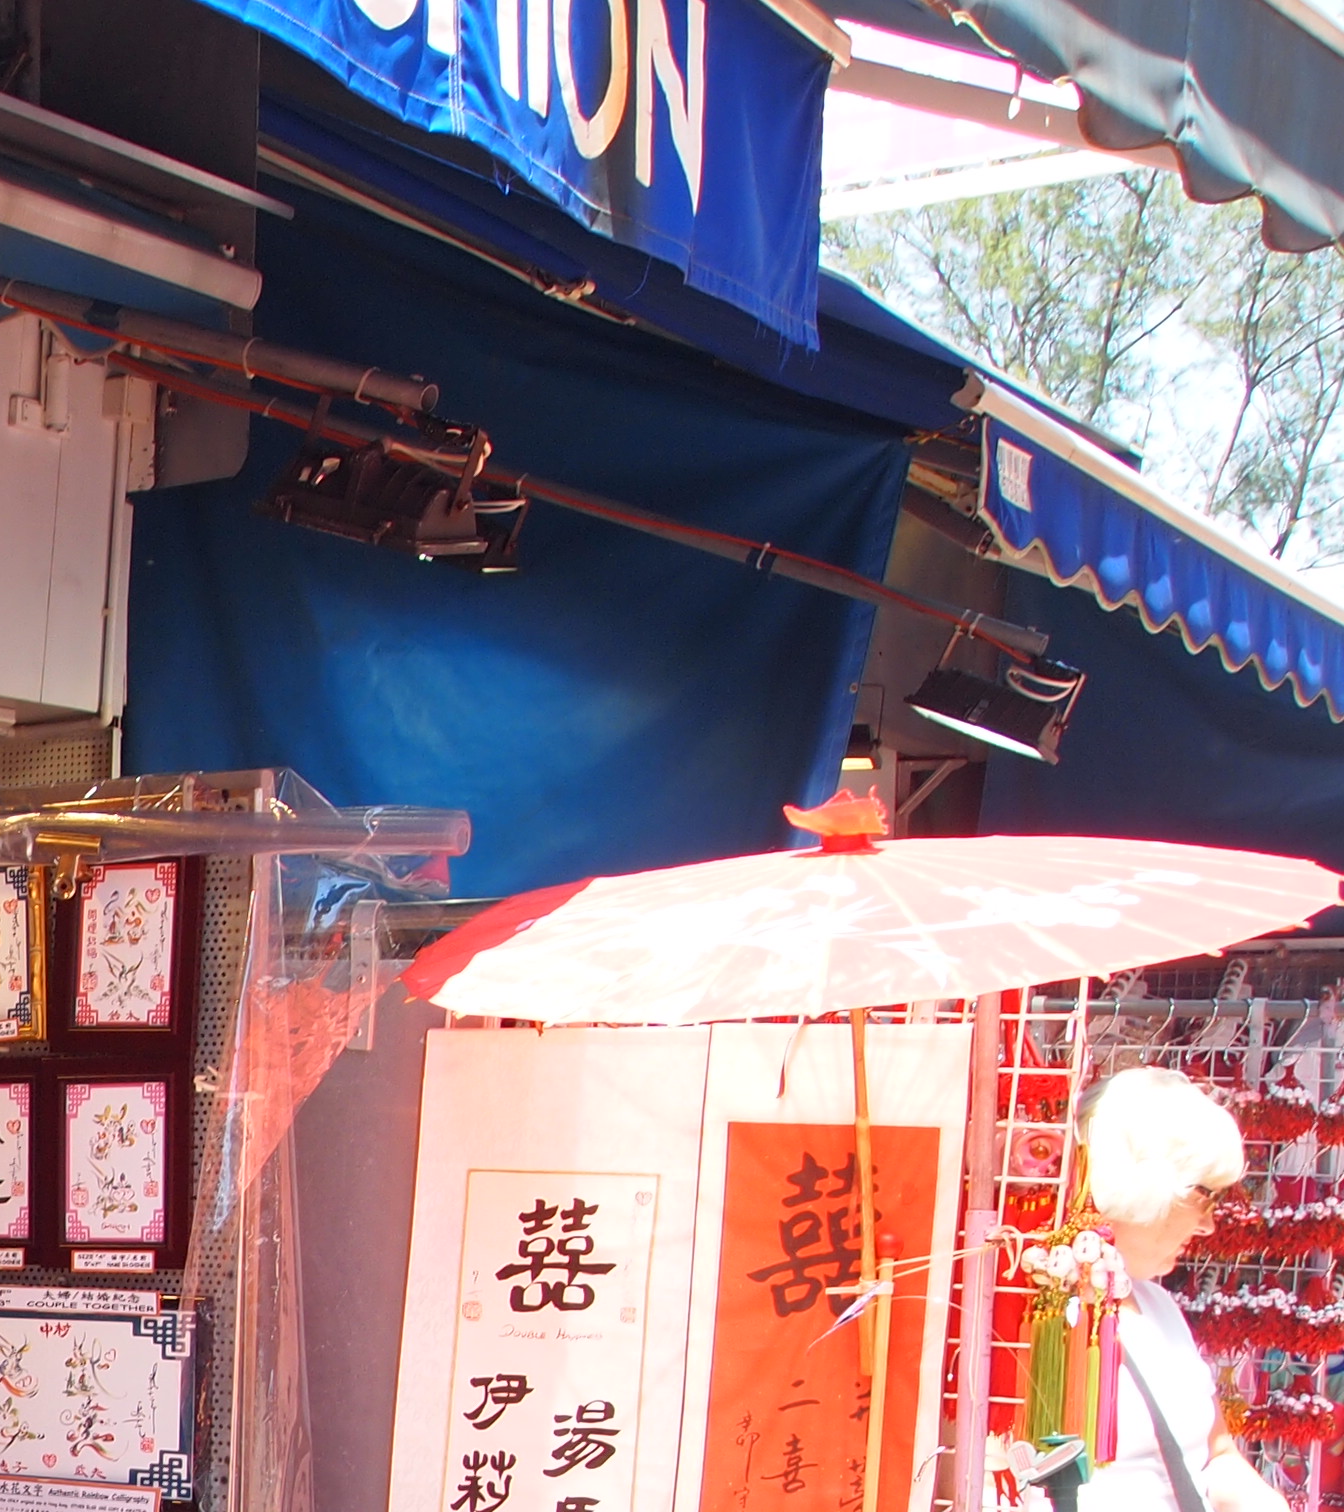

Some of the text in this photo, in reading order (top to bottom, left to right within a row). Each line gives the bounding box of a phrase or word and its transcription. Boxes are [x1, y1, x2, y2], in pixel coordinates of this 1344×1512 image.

[26, 1300, 155, 1313] COUPLE TOGETHER
[48, 1487, 80, 1499] Authentic
[82, 1490, 110, 1501] Rainbow
[111, 1492, 152, 1505] Calligraphy
